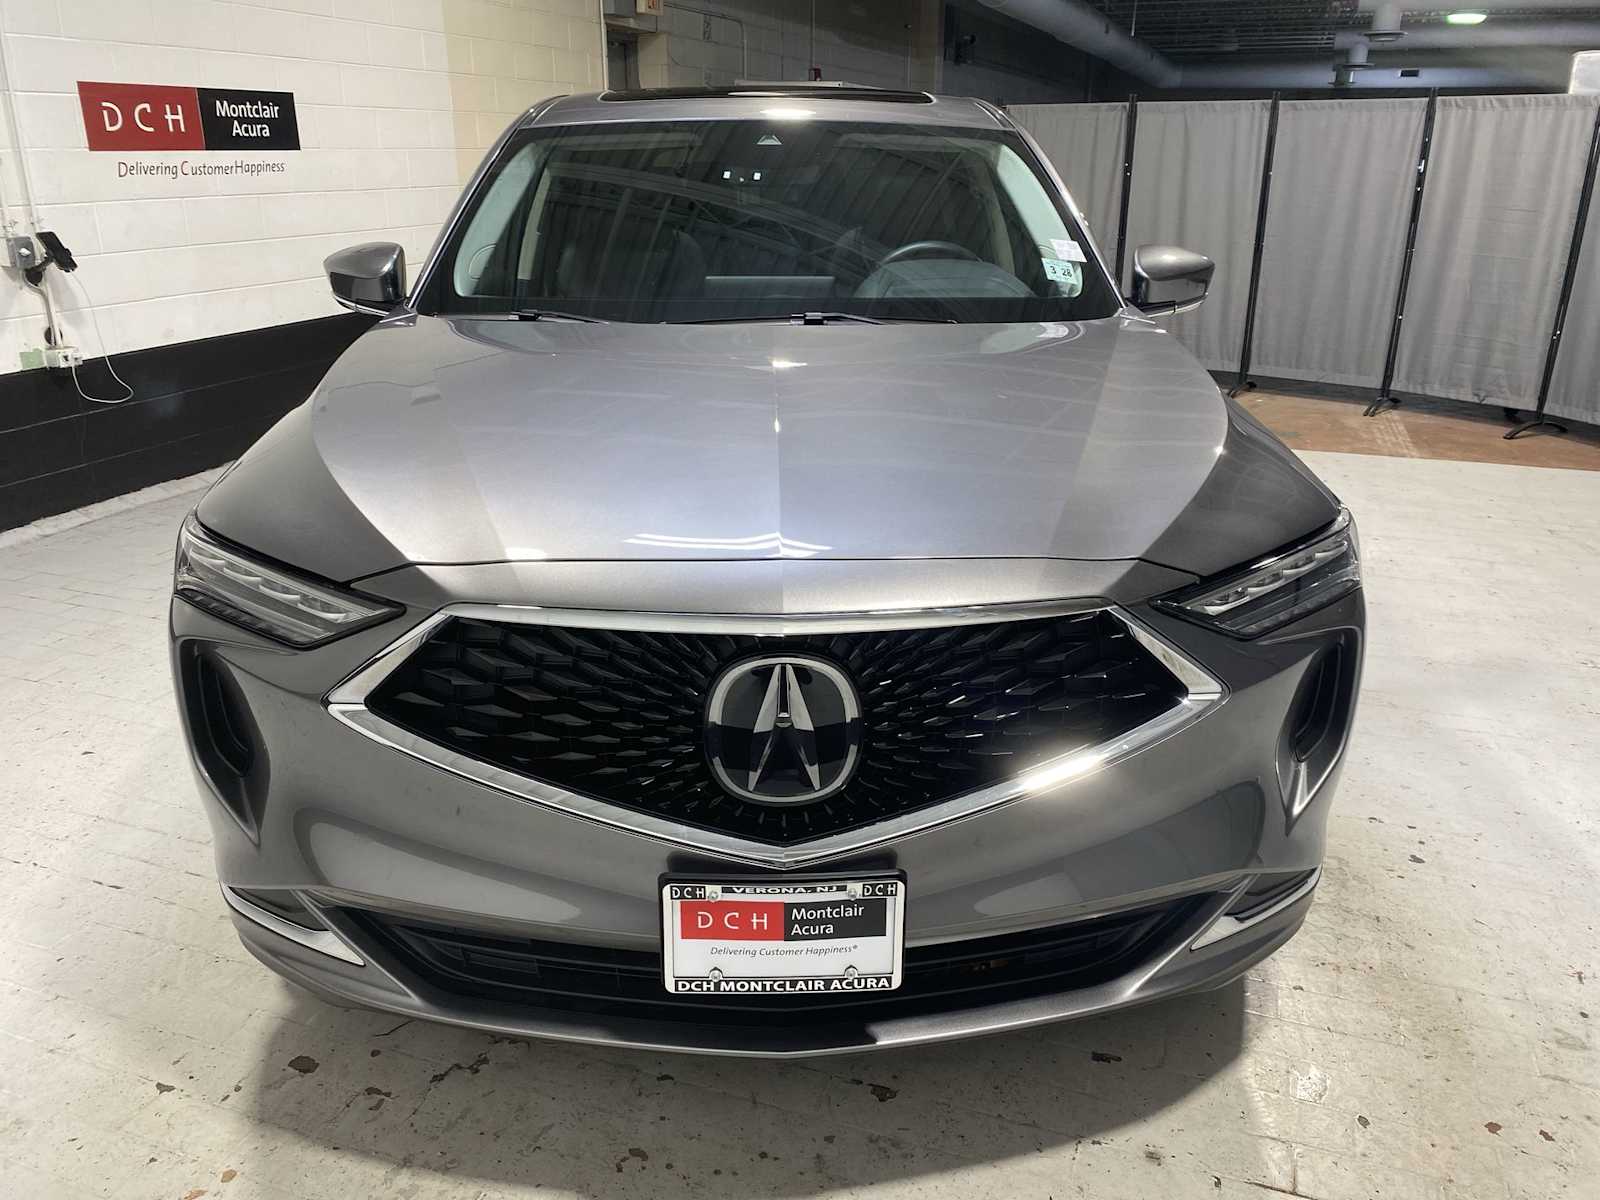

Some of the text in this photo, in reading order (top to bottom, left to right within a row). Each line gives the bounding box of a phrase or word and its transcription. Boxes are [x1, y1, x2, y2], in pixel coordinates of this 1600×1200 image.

[215, 100, 280, 119] Montclair
[231, 120, 270, 137] Acura
[117, 160, 285, 180] Delivering Customer Happiness
[671, 887, 705, 899] DCH
[863, 883, 897, 896] DCH
[696, 911, 768, 930] DCH
[791, 904, 865, 921] Montclair
[790, 923, 835, 936] Acura
[710, 947, 757, 958] Delivering
[759, 946, 804, 956] Customer
[677, 977, 890, 992] DCH MONTCLAIR ACURA
